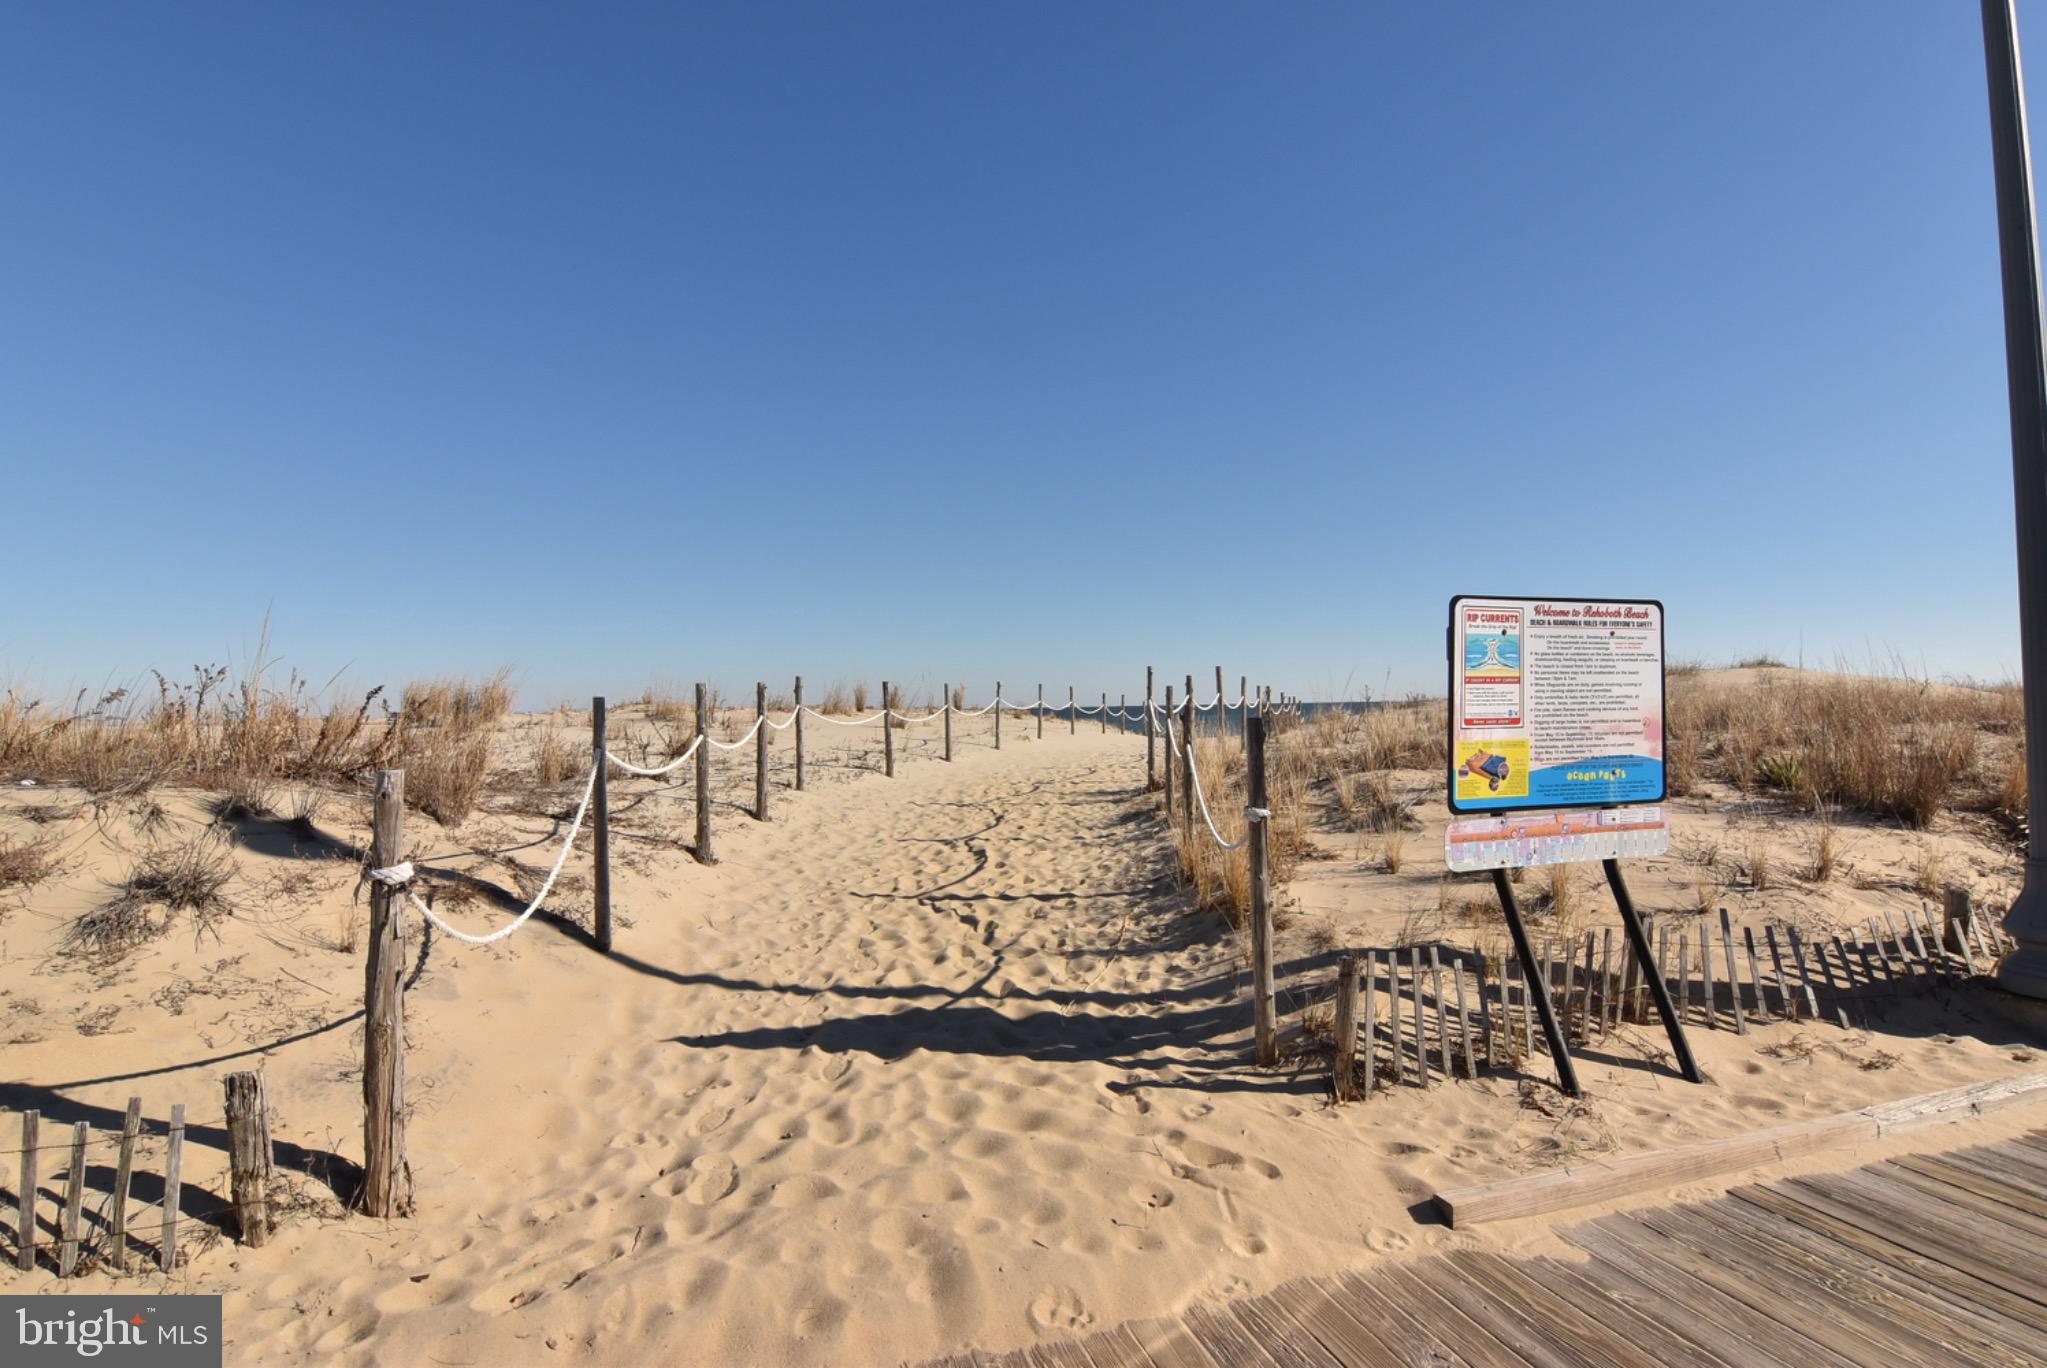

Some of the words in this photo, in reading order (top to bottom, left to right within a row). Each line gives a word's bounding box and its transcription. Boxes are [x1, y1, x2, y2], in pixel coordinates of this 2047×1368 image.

[1534, 604, 1570, 617] Welcome
[1572, 608, 1581, 617] to
[1583, 605, 1622, 618] Rehoboth
[1624, 607, 1649, 618] Beach
[1467, 613, 1479, 622] RIP
[1480, 613, 1520, 624] CURRENTS
